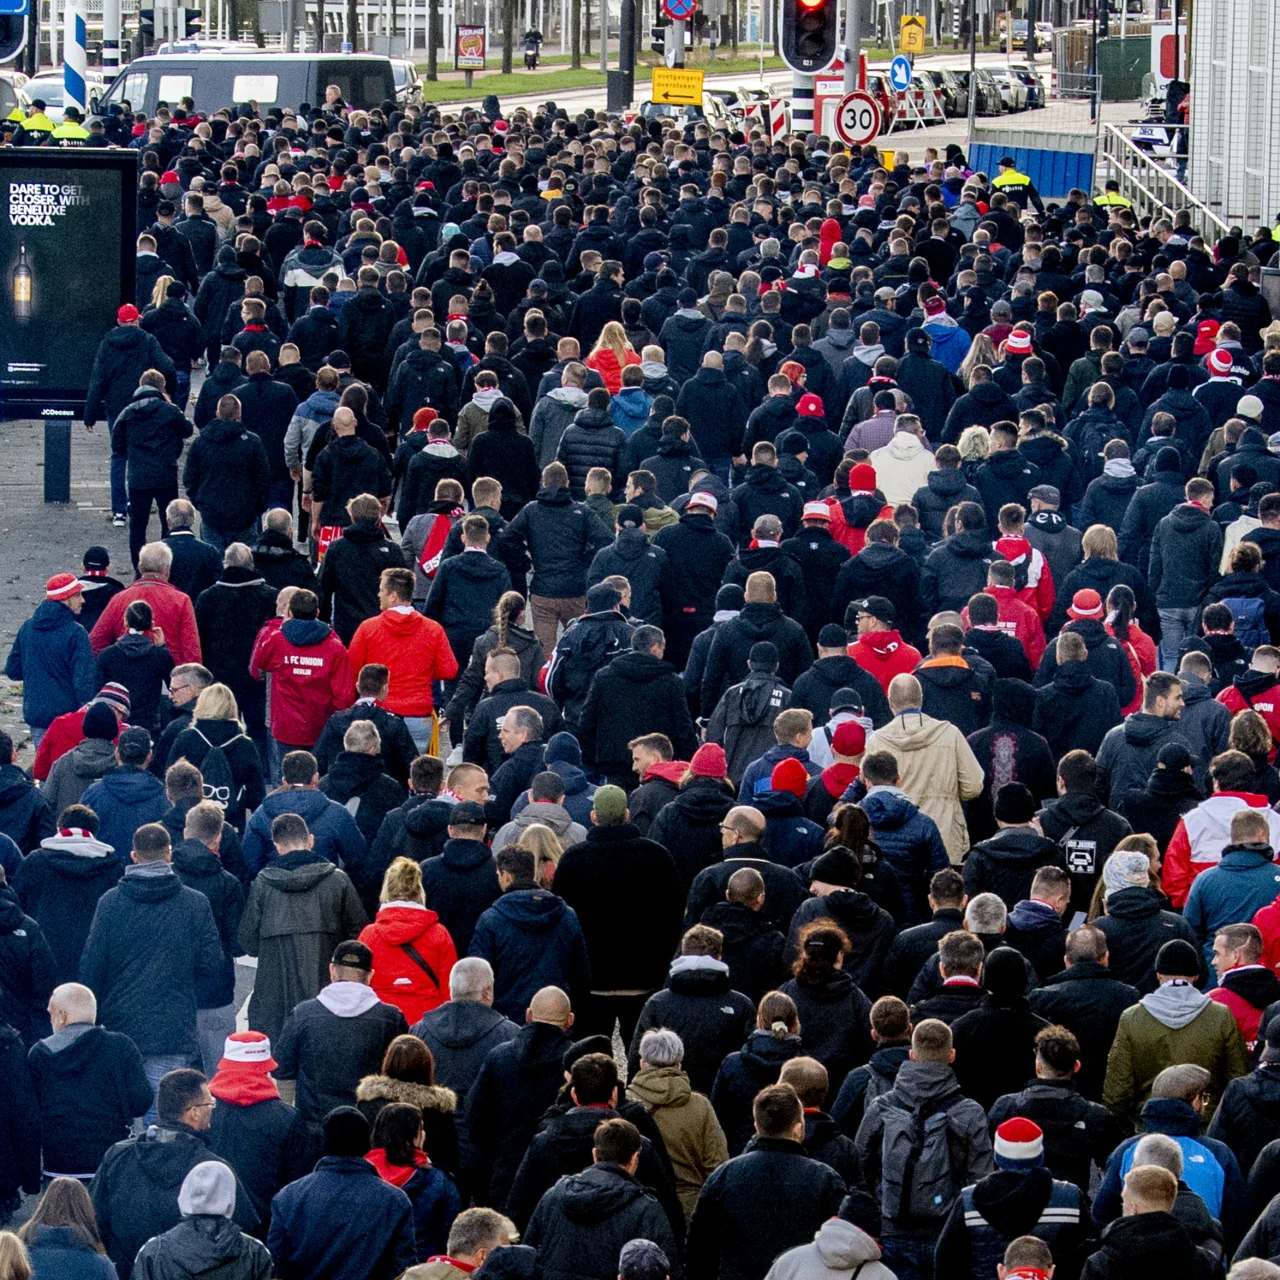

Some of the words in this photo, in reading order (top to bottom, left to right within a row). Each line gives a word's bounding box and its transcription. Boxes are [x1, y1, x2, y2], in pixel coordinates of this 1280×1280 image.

[844, 108, 872, 130] 30
[10, 183, 41, 194] DARE
[42, 184, 60, 195] TO
[61, 185, 82, 195] GET
[9, 194, 57, 205] CLOSER.
[59, 195, 90, 206] WITH
[9, 204, 66, 216] BENELUXE
[9, 215, 55, 226] VODKA.
[290, 656, 300, 665] FC
[300, 656, 323, 667] UNION
